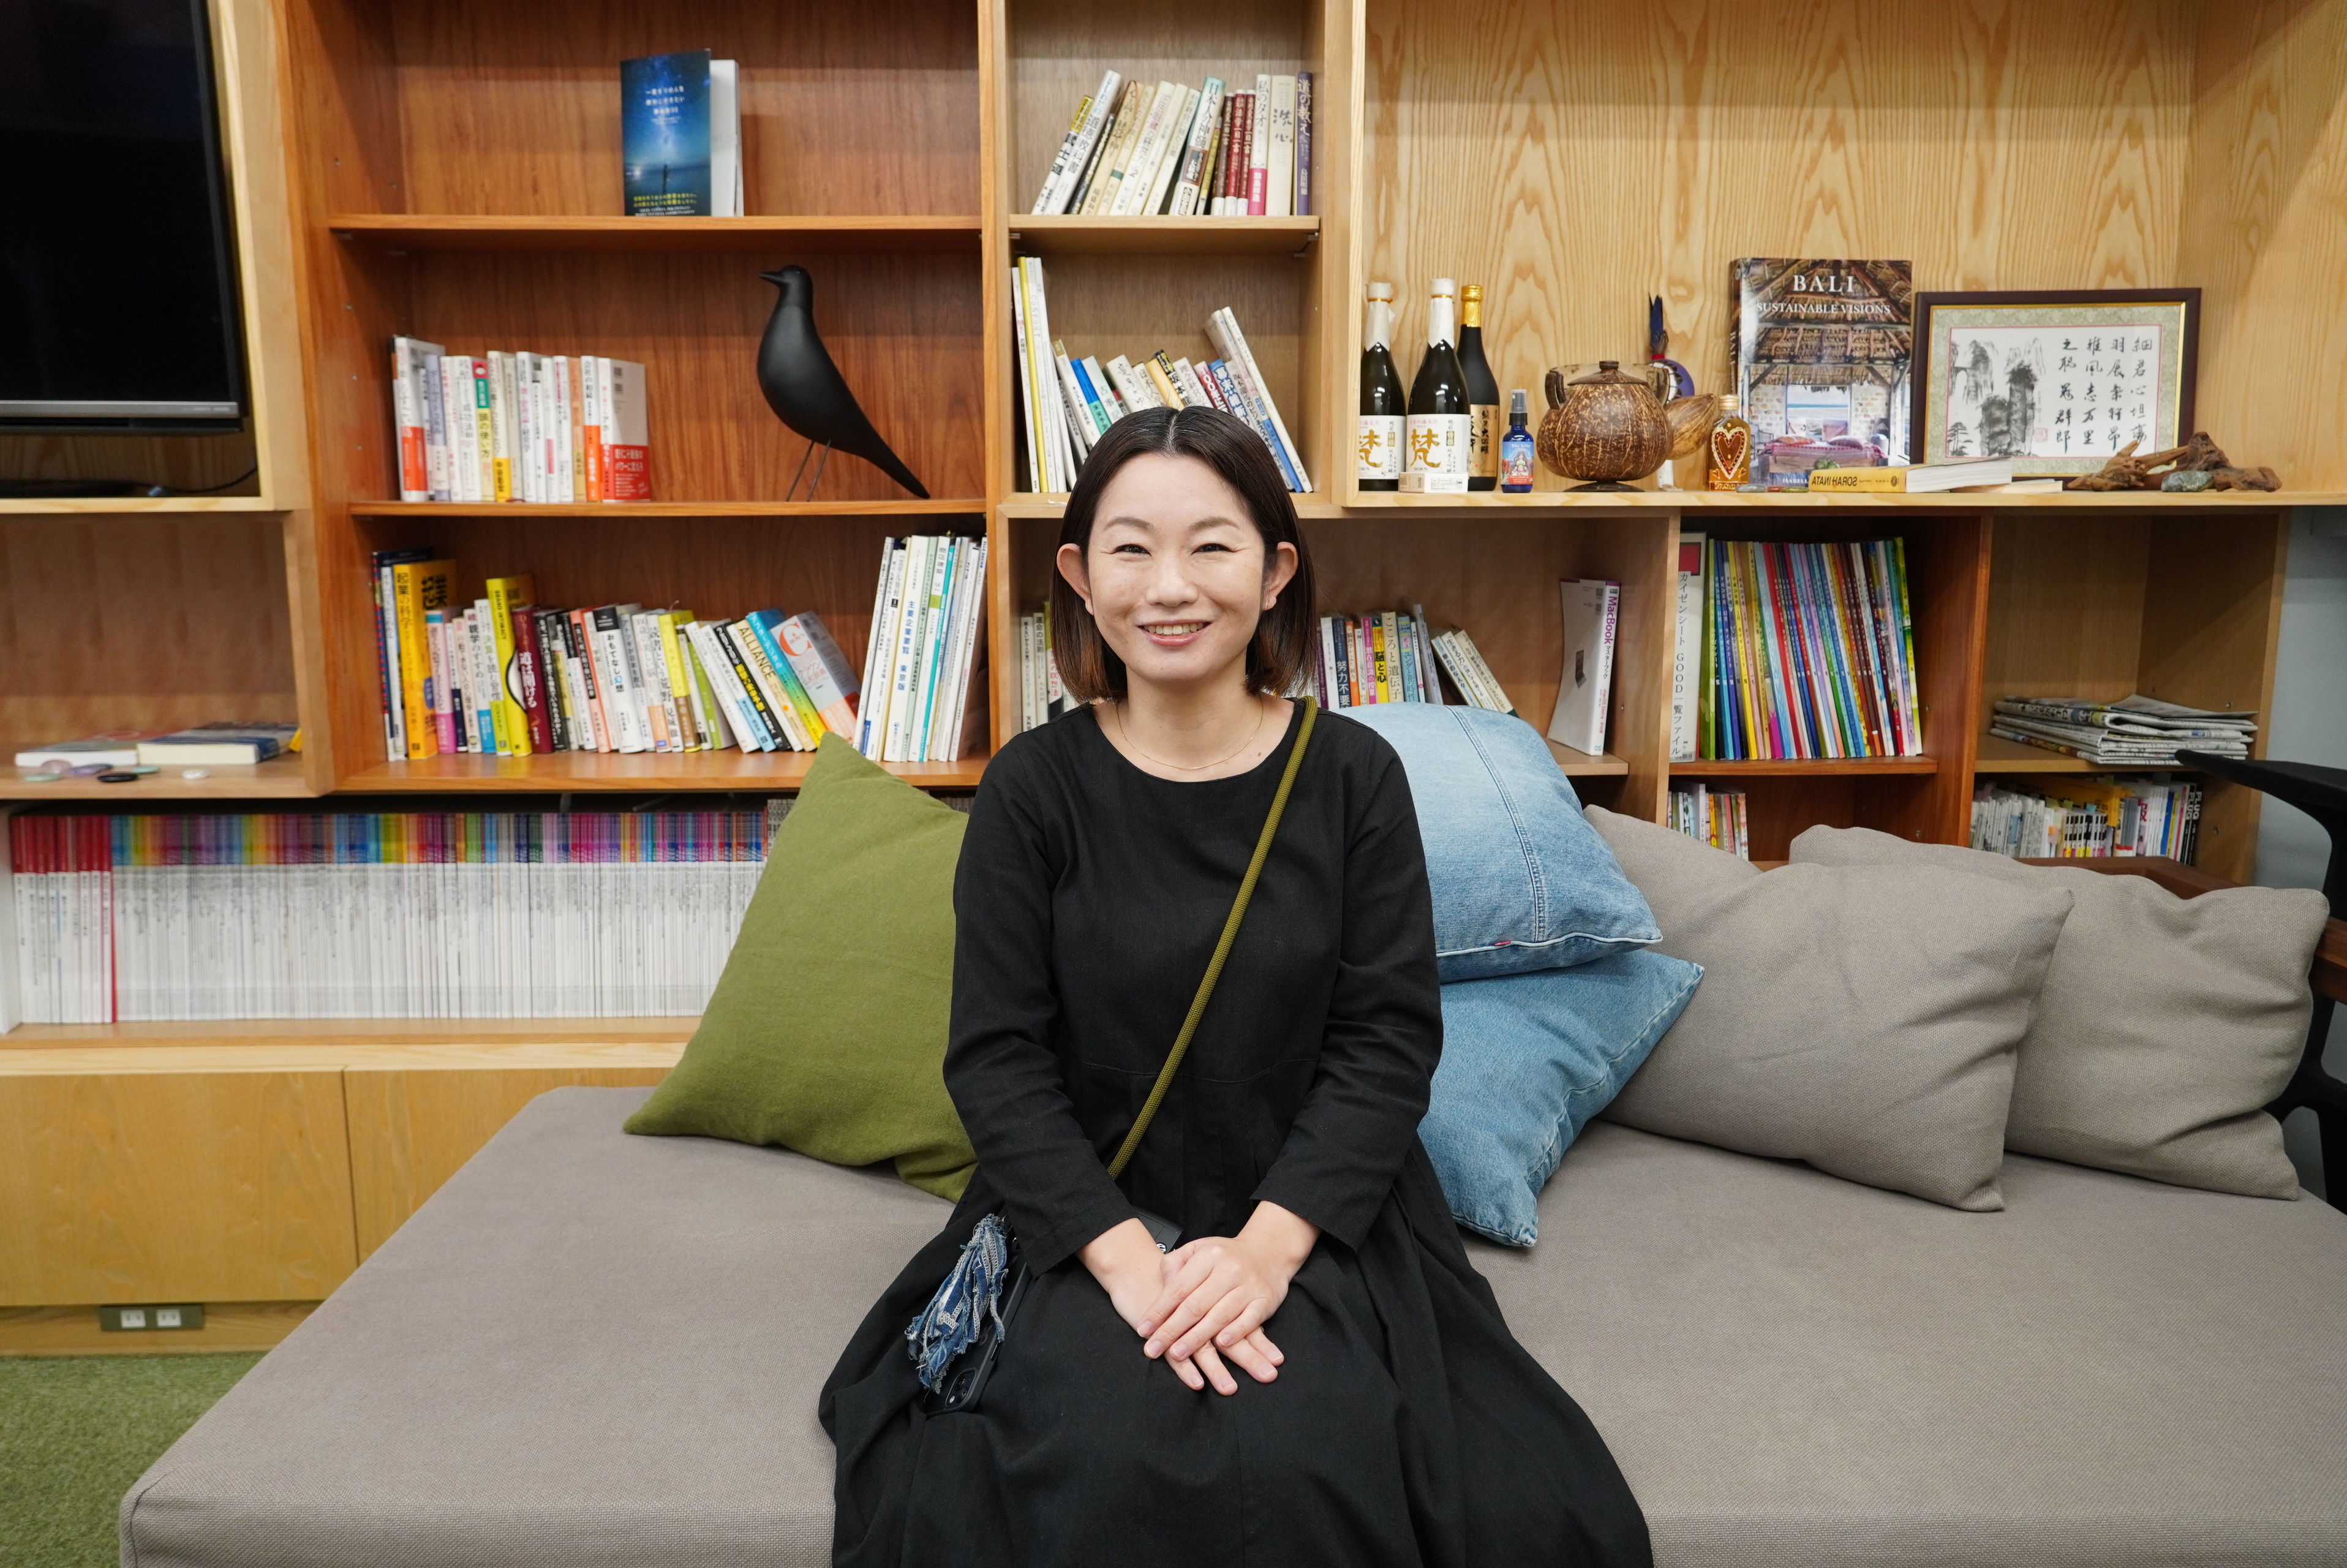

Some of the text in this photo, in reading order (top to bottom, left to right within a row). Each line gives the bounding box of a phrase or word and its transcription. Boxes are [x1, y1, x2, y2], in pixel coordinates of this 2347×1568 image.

[1793, 275, 1855, 293] BALI
[1757, 303, 1891, 315] SUSTAINABLE VISIONS
[1677, 573, 1689, 647] カイゼンシート
[739, 625, 772, 681] ALLIANCE
[1601, 596, 1618, 679] MacBook マスターブック
[1374, 650, 1386, 683] 脳と心
[1384, 617, 1401, 699] こころと遺伝子
[1442, 652, 1466, 689] 魅力的な人々
[2193, 791, 2202, 820] PLUG
